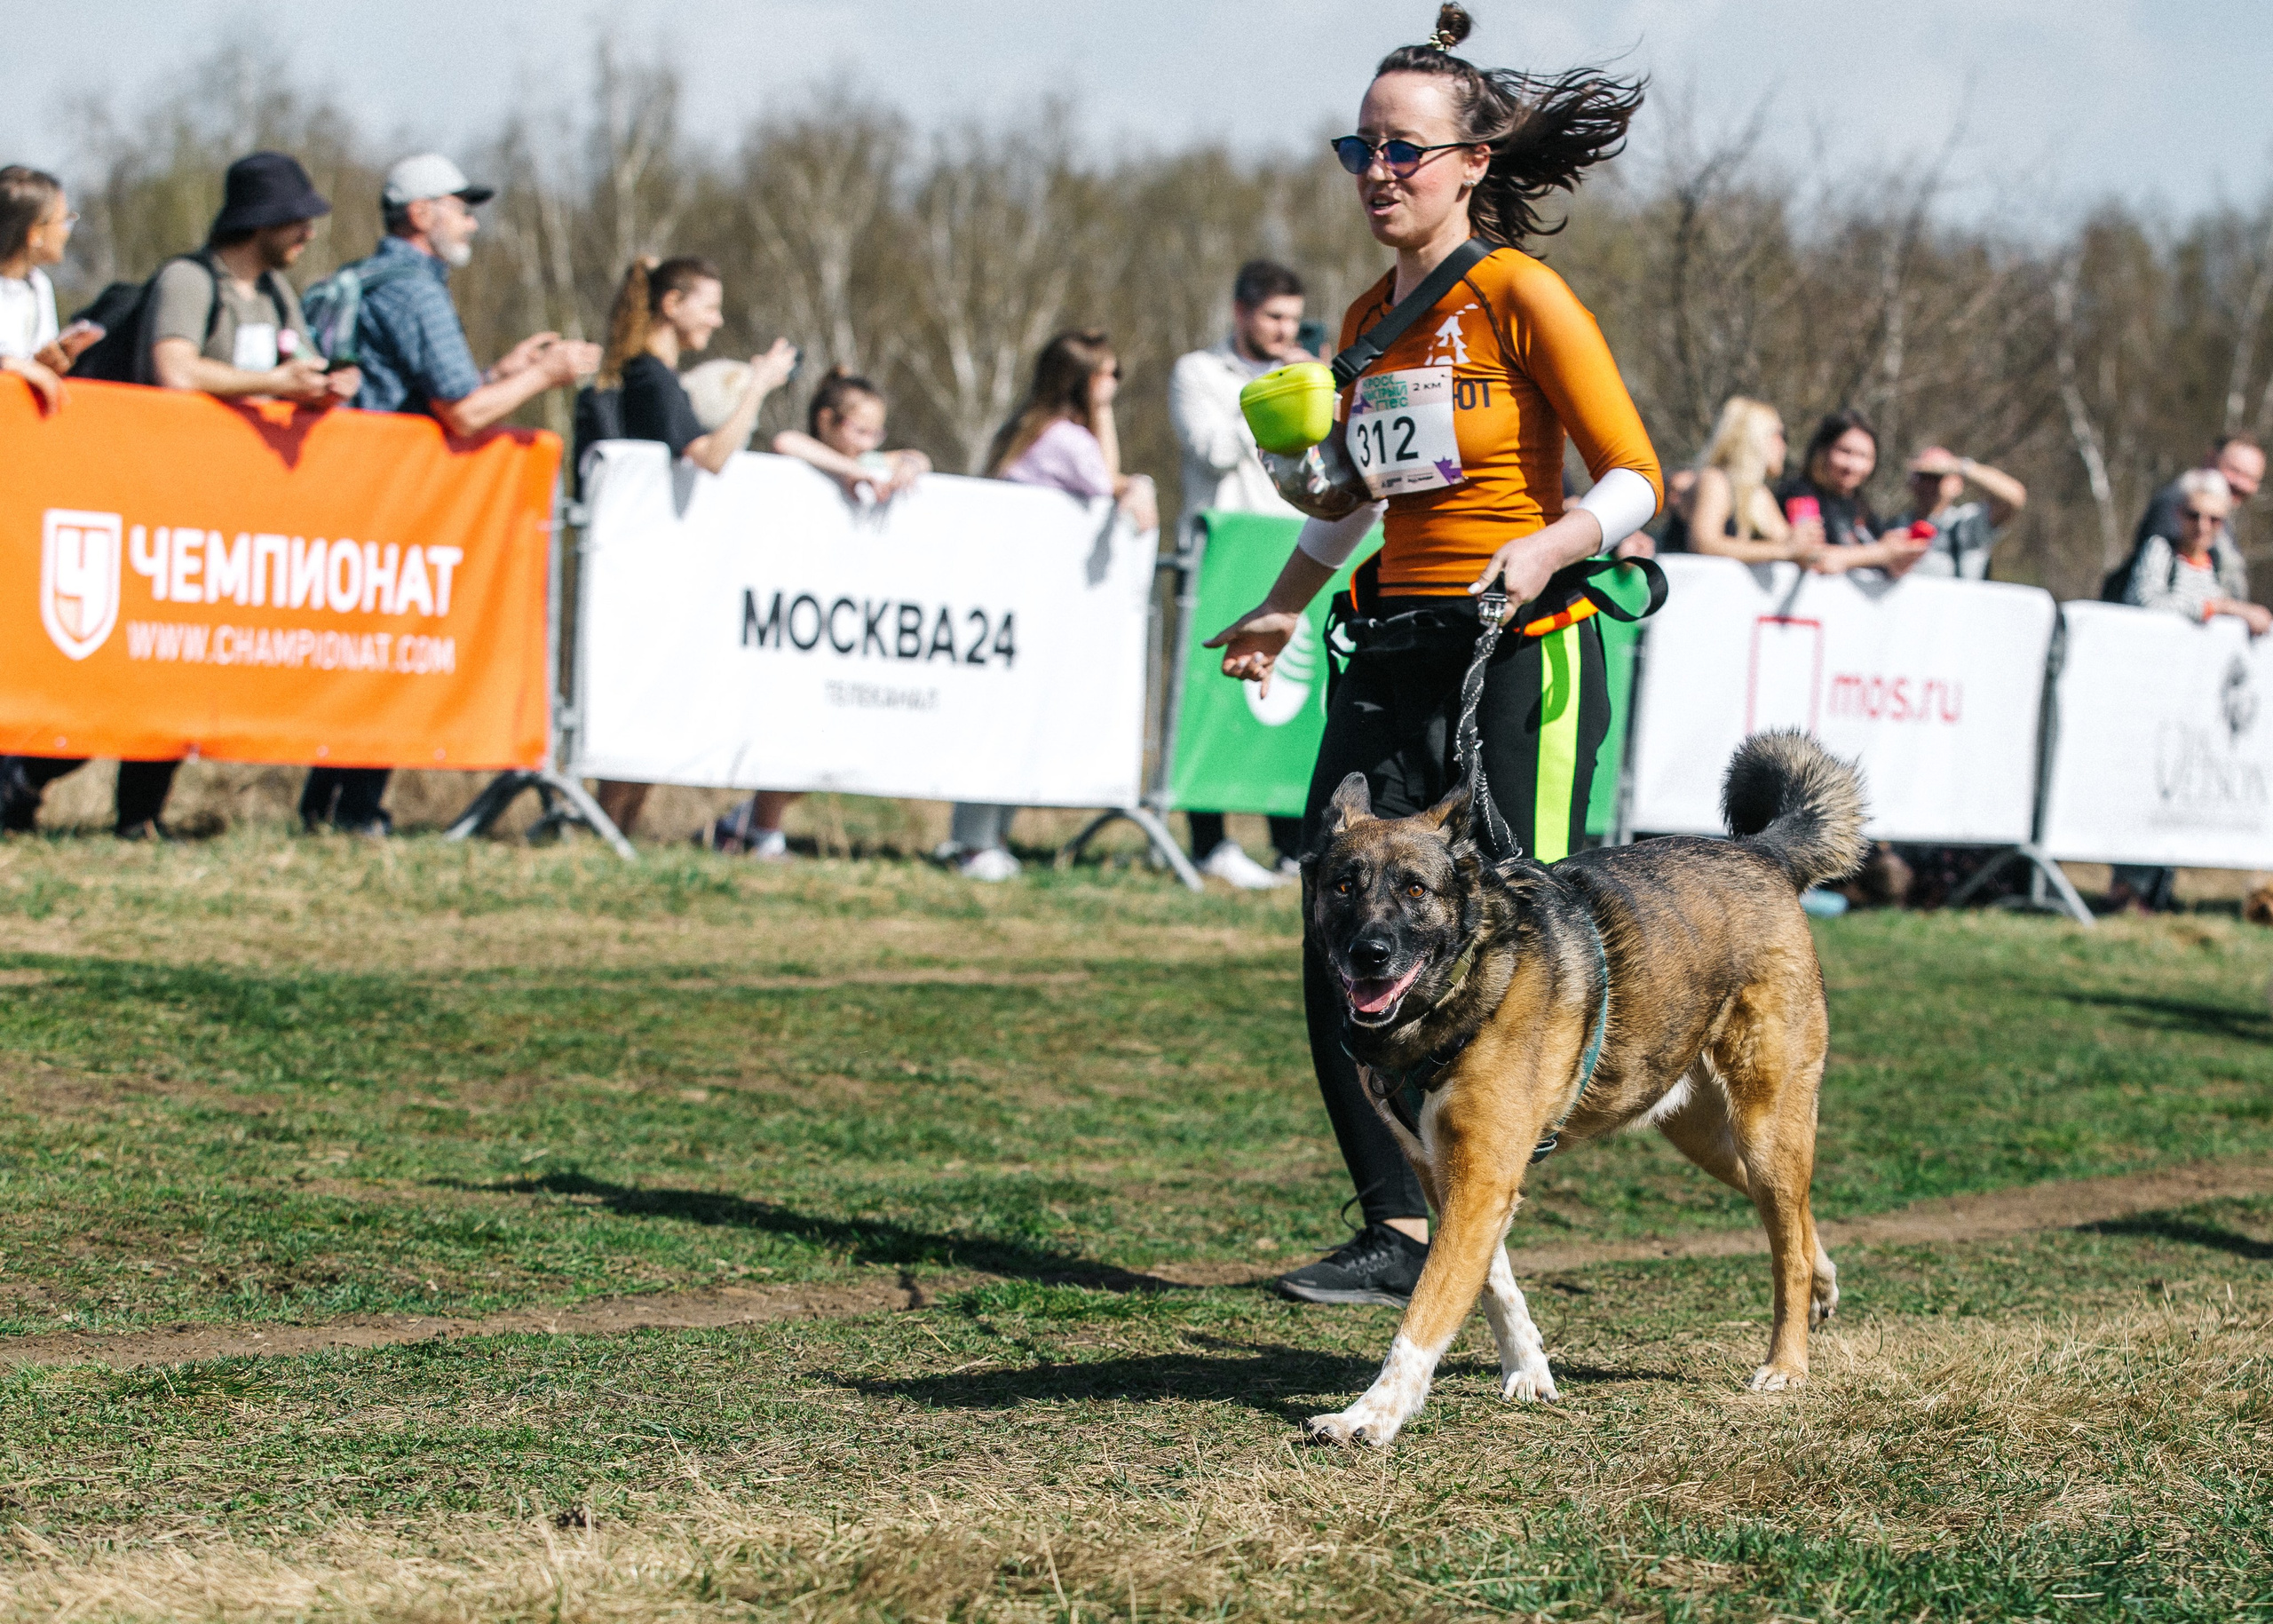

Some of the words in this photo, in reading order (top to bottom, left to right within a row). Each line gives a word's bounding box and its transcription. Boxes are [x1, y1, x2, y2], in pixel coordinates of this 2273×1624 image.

[1413, 383, 1421, 392] 2
[1357, 416, 1419, 468] 312
[129, 524, 463, 617] ЧЕМПИОНАТ
[126, 620, 456, 675] WWW.CHAMPIONAT.COM
[741, 587, 1017, 669] МОСКВА24
[1828, 671, 1963, 723] mos.ru
